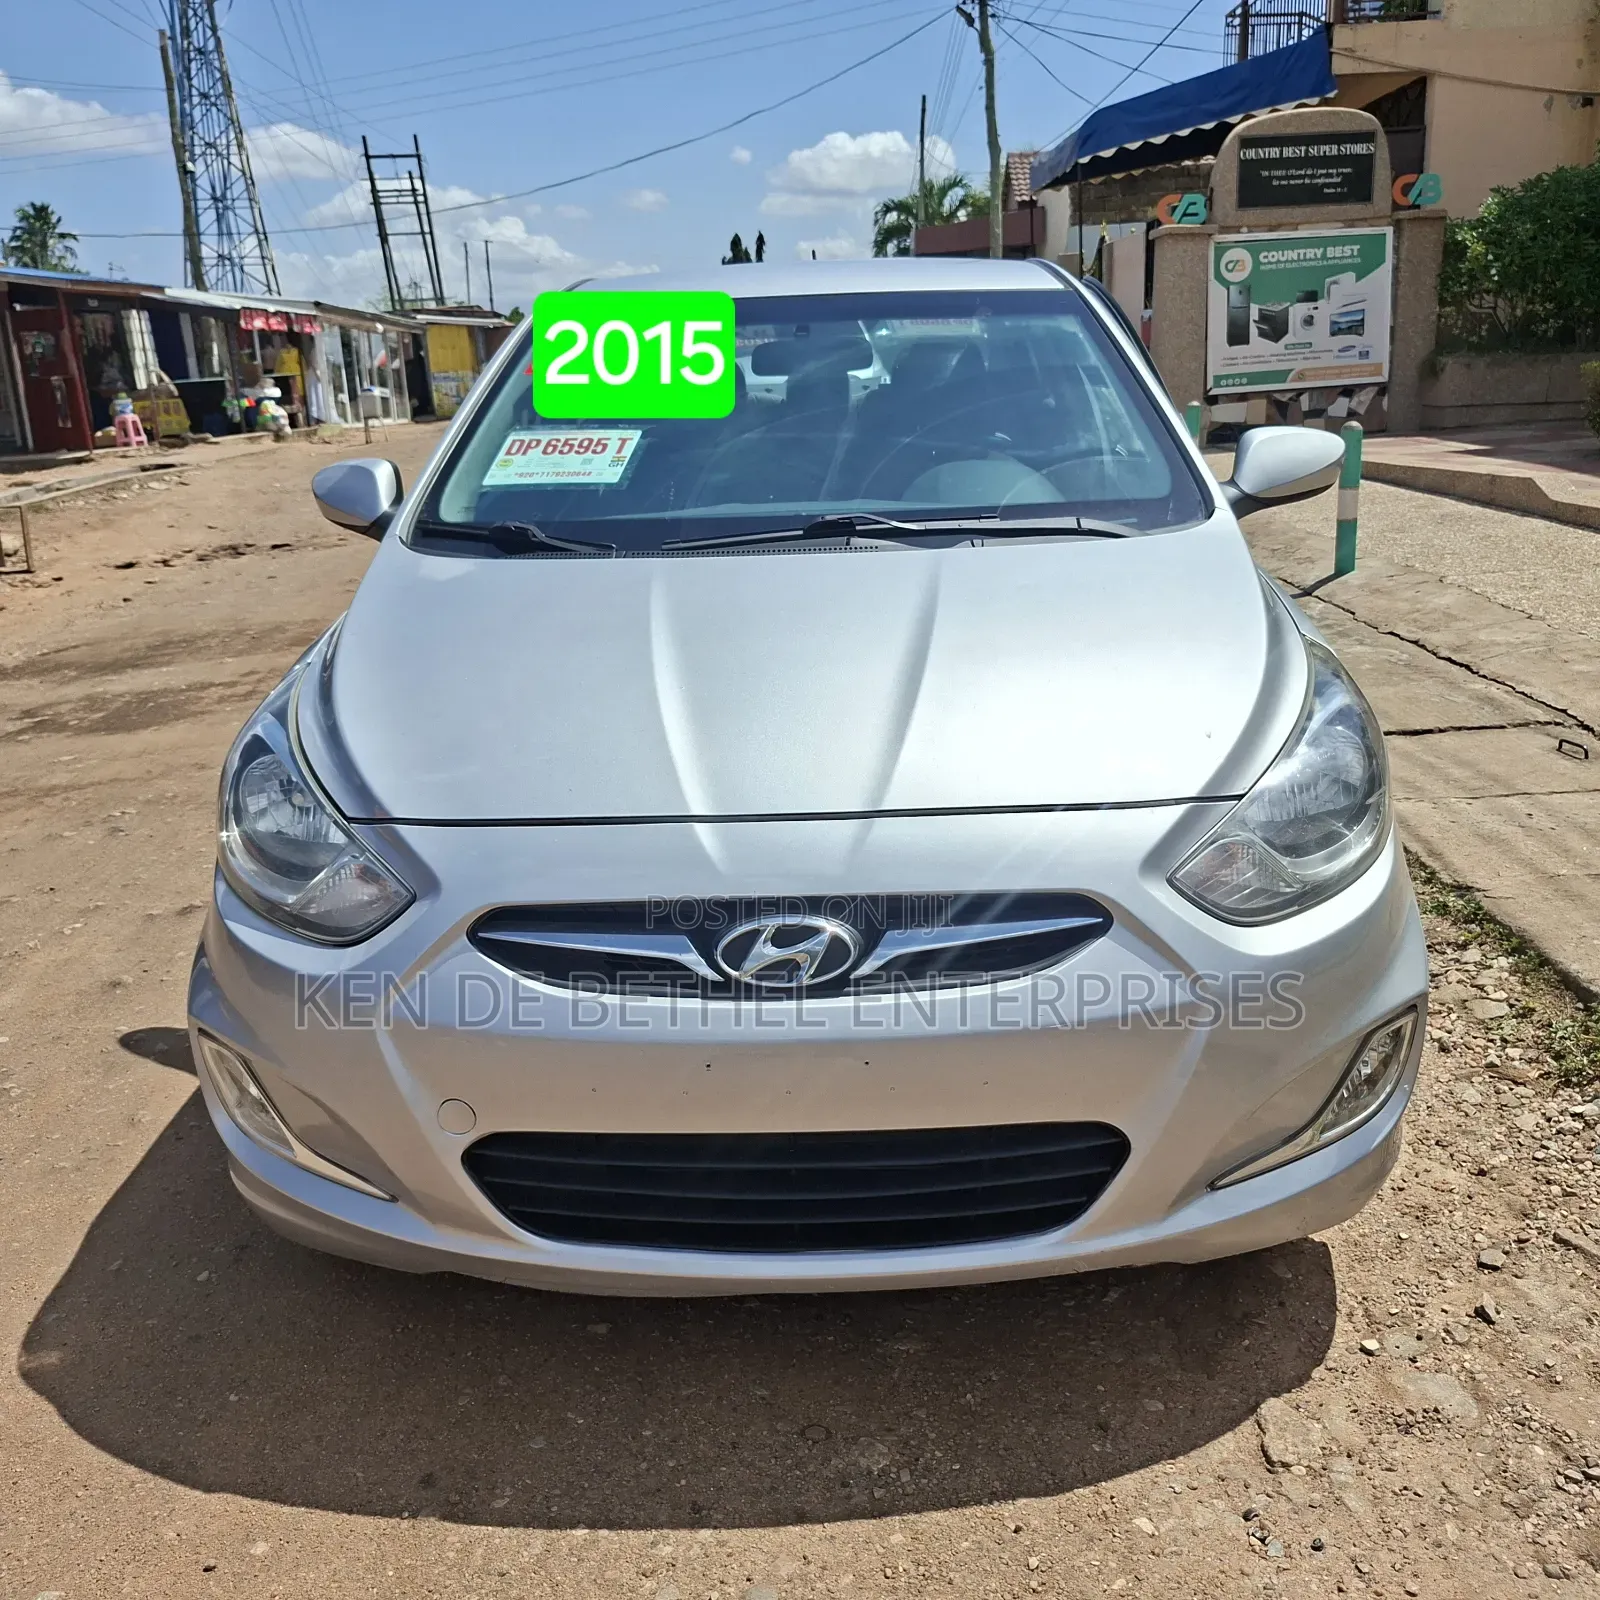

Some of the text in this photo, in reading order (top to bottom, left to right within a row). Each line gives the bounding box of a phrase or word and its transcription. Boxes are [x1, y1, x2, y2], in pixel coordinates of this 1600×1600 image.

[1240, 142, 1375, 160] COUNTRY BEST SUPER STORES
[1259, 245, 1360, 263] COUNTRY BEST
[1286, 260, 1323, 269] ELECTRONICS
[1327, 257, 1361, 266] APPLIANCES
[504, 437, 634, 456] DP 6595 T
